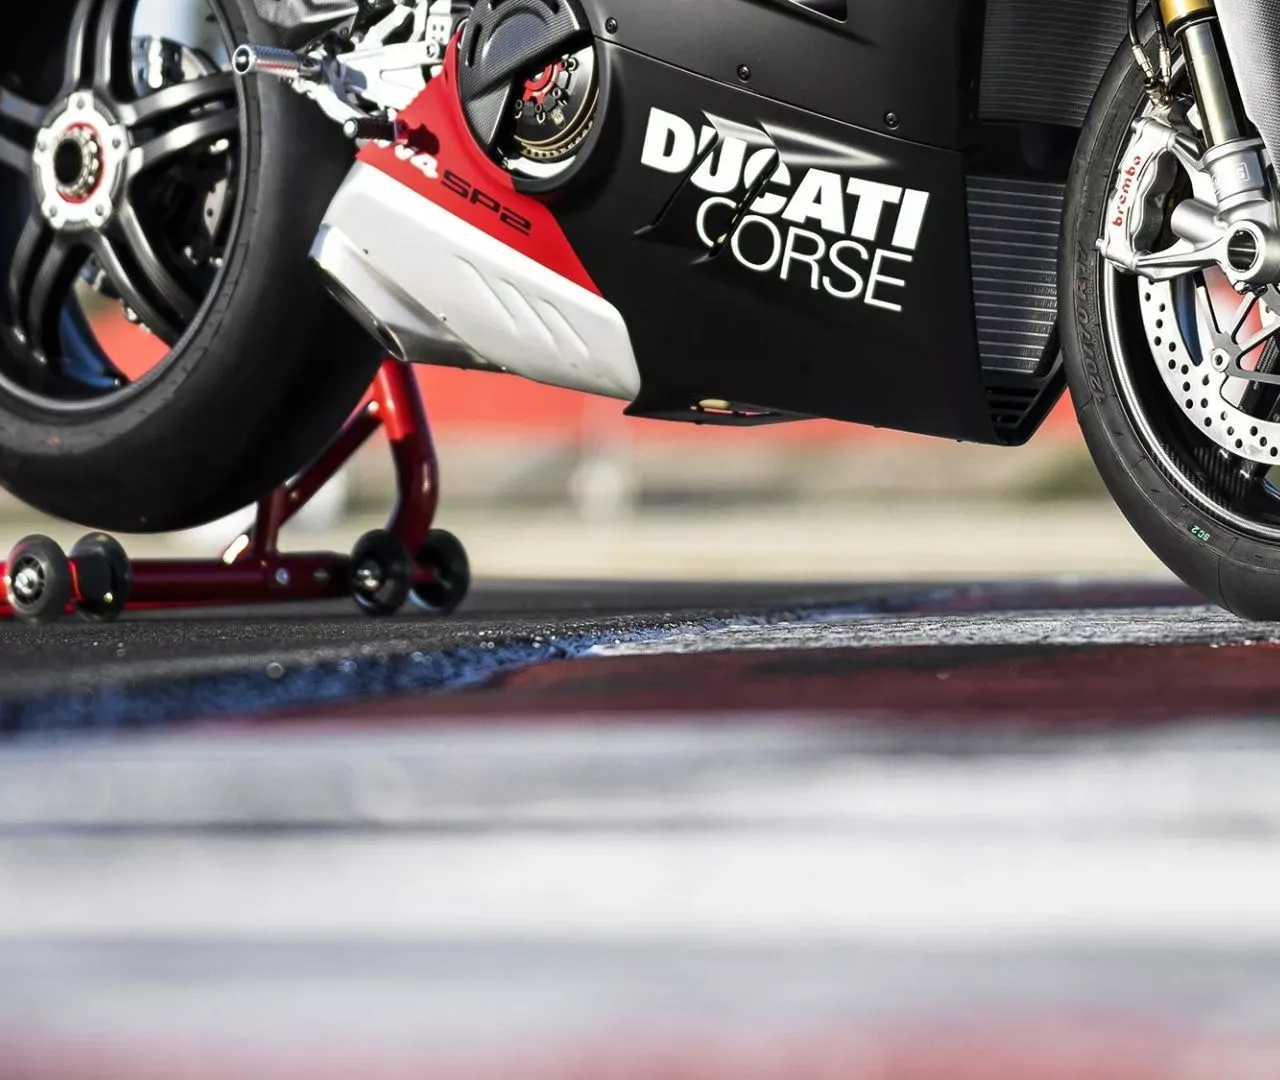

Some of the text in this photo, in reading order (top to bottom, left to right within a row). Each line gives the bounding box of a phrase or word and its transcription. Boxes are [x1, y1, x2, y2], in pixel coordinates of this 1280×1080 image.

[440, 169, 533, 236] SP2
[640, 107, 930, 251] DUCATI
[1111, 155, 1142, 228] brembo
[696, 196, 915, 312] CORSE
[1191, 525, 1211, 542] SC2
